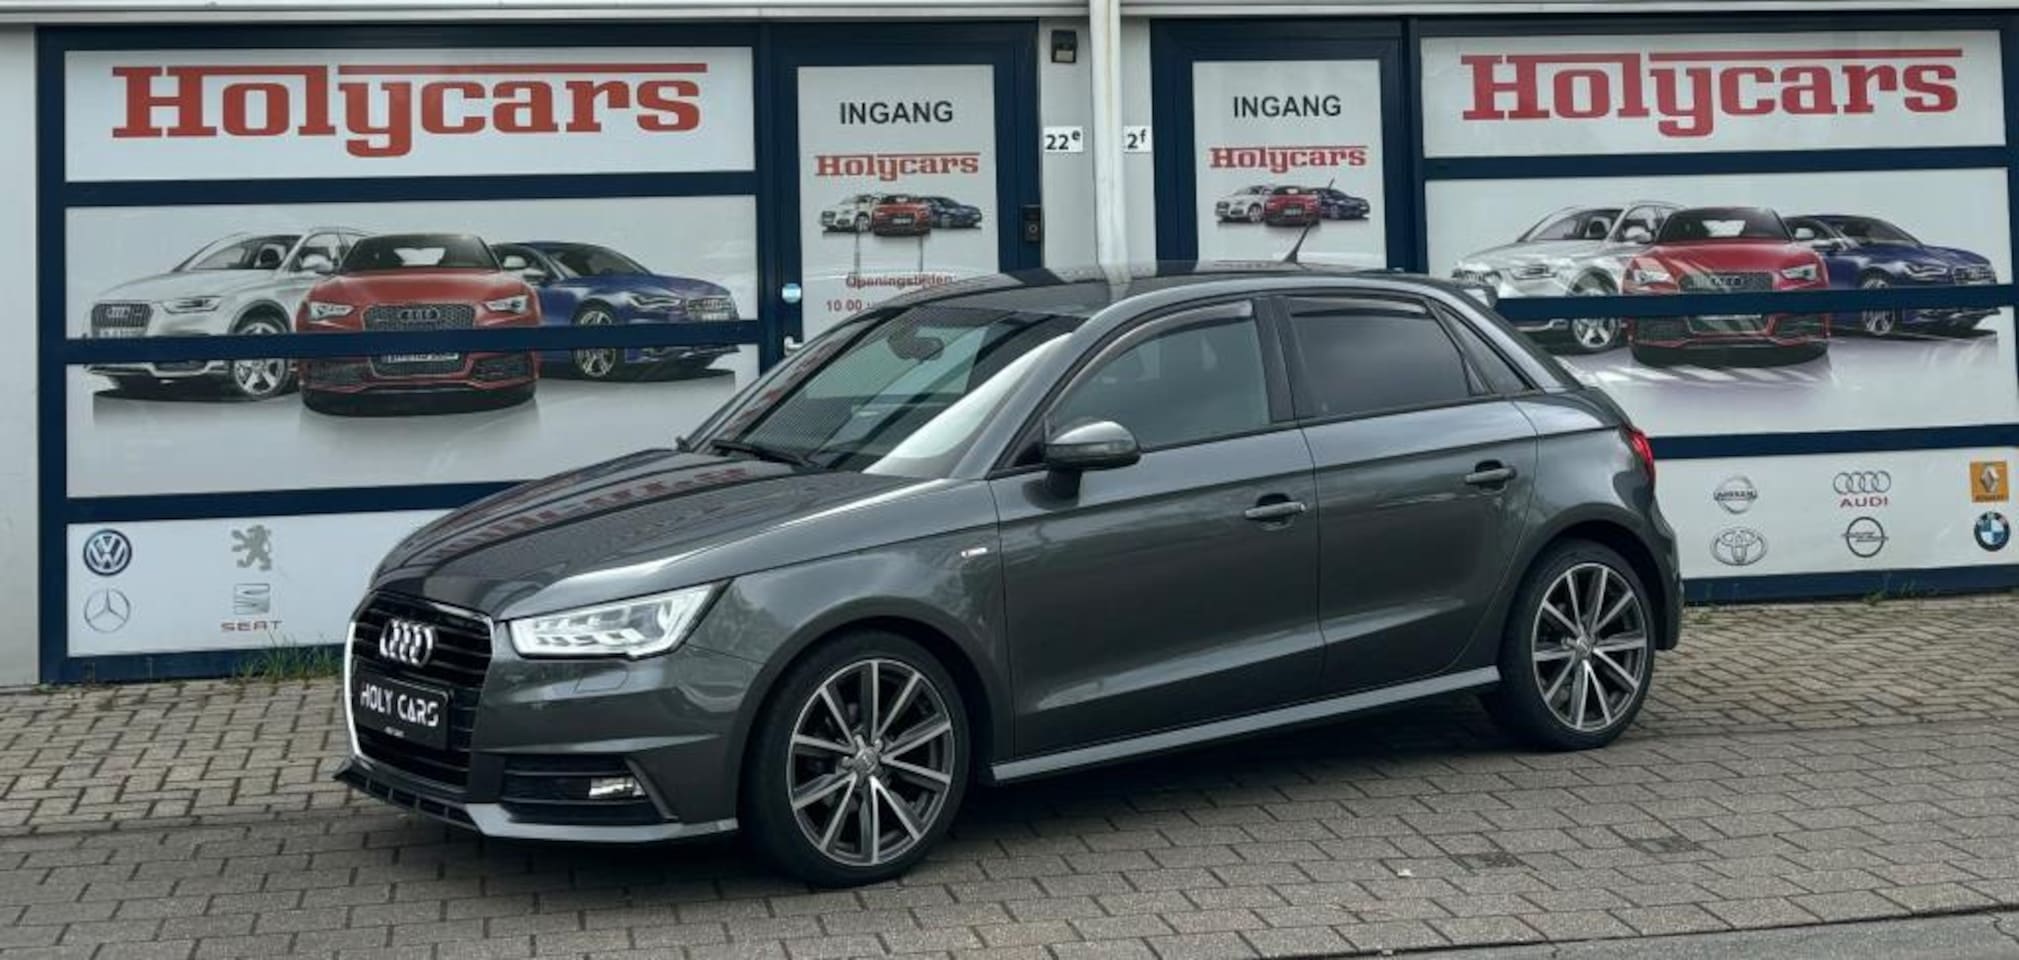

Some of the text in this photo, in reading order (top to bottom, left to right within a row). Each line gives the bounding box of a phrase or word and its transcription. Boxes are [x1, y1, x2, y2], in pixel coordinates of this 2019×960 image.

[1234, 94, 1342, 118] INGANG
[1461, 49, 1963, 138] Holycars
[113, 62, 707, 158] Holycars
[839, 101, 953, 125] INGANG
[815, 152, 980, 182] Holycars
[1210, 145, 1368, 174] Holycars
[1840, 496, 1888, 508] AUDI
[220, 619, 283, 632] SEAT
[360, 682, 439, 727] HOLY CARS
